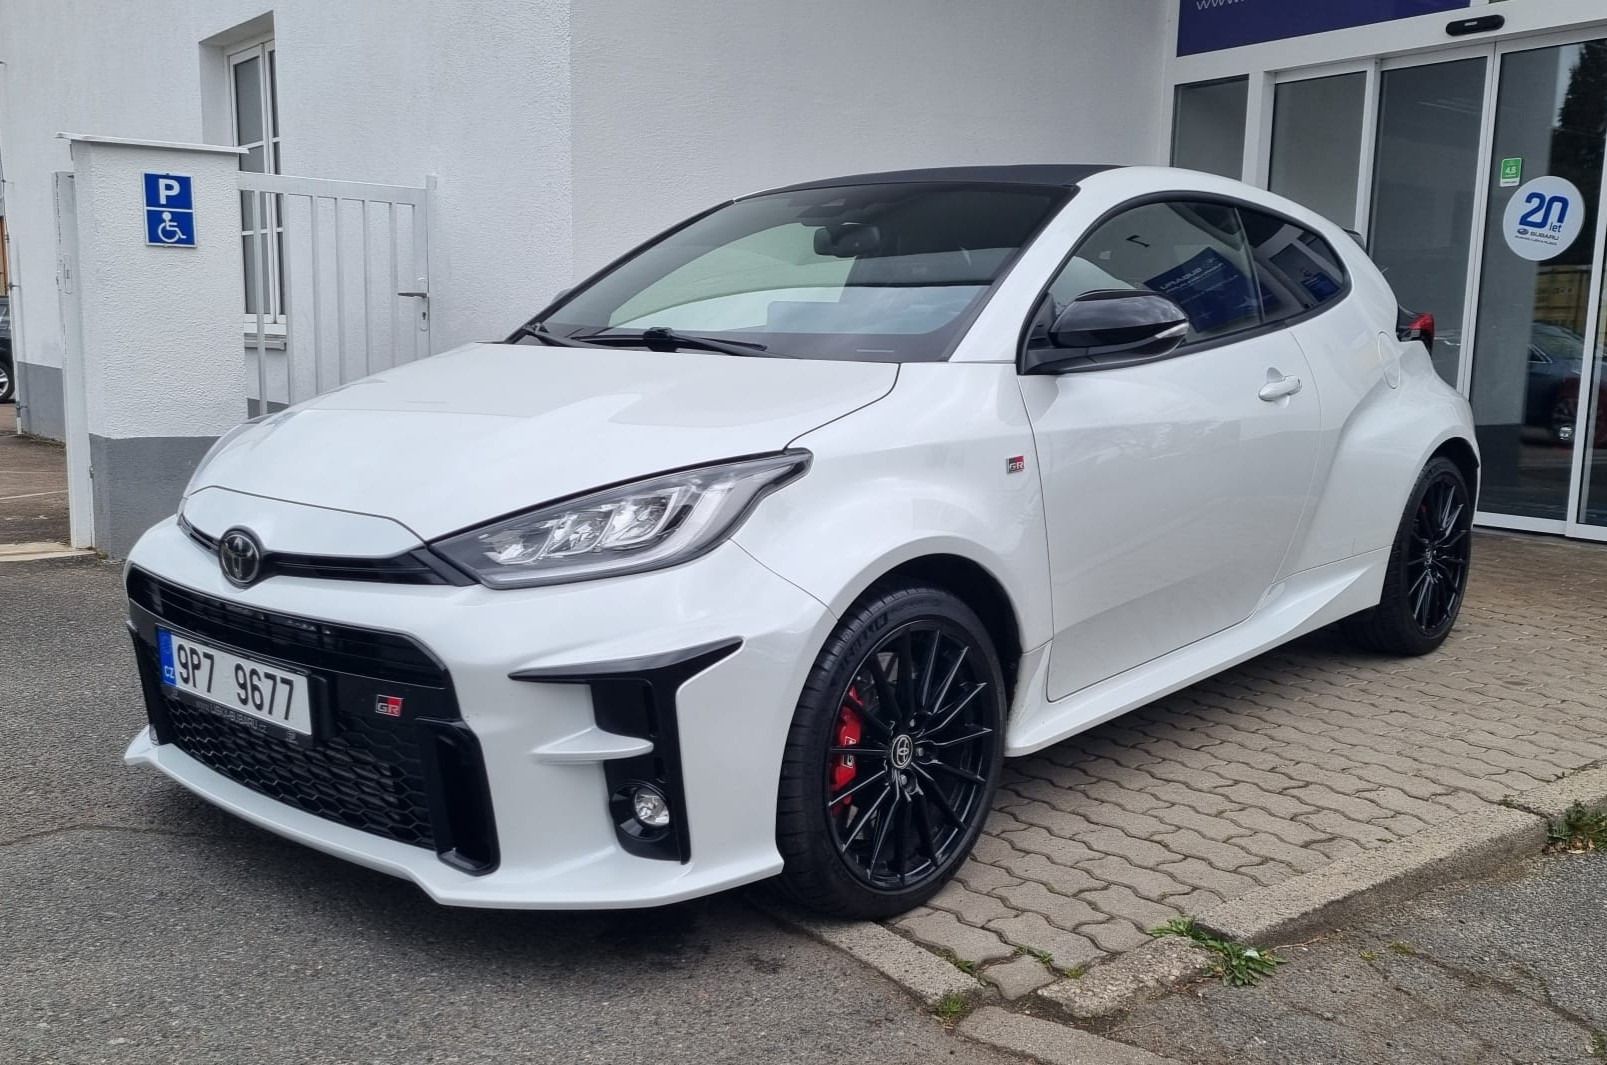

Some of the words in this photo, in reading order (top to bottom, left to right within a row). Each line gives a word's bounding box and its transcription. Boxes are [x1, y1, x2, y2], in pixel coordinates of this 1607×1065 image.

[158, 178, 180, 205] P
[1518, 191, 1569, 229] 20
[1549, 221, 1562, 233] let
[1530, 231, 1560, 241] SUBARU
[164, 665, 175, 679] CZ
[176, 643, 215, 693] 9P7
[234, 662, 294, 721] 9677
[377, 702, 400, 715] GR
